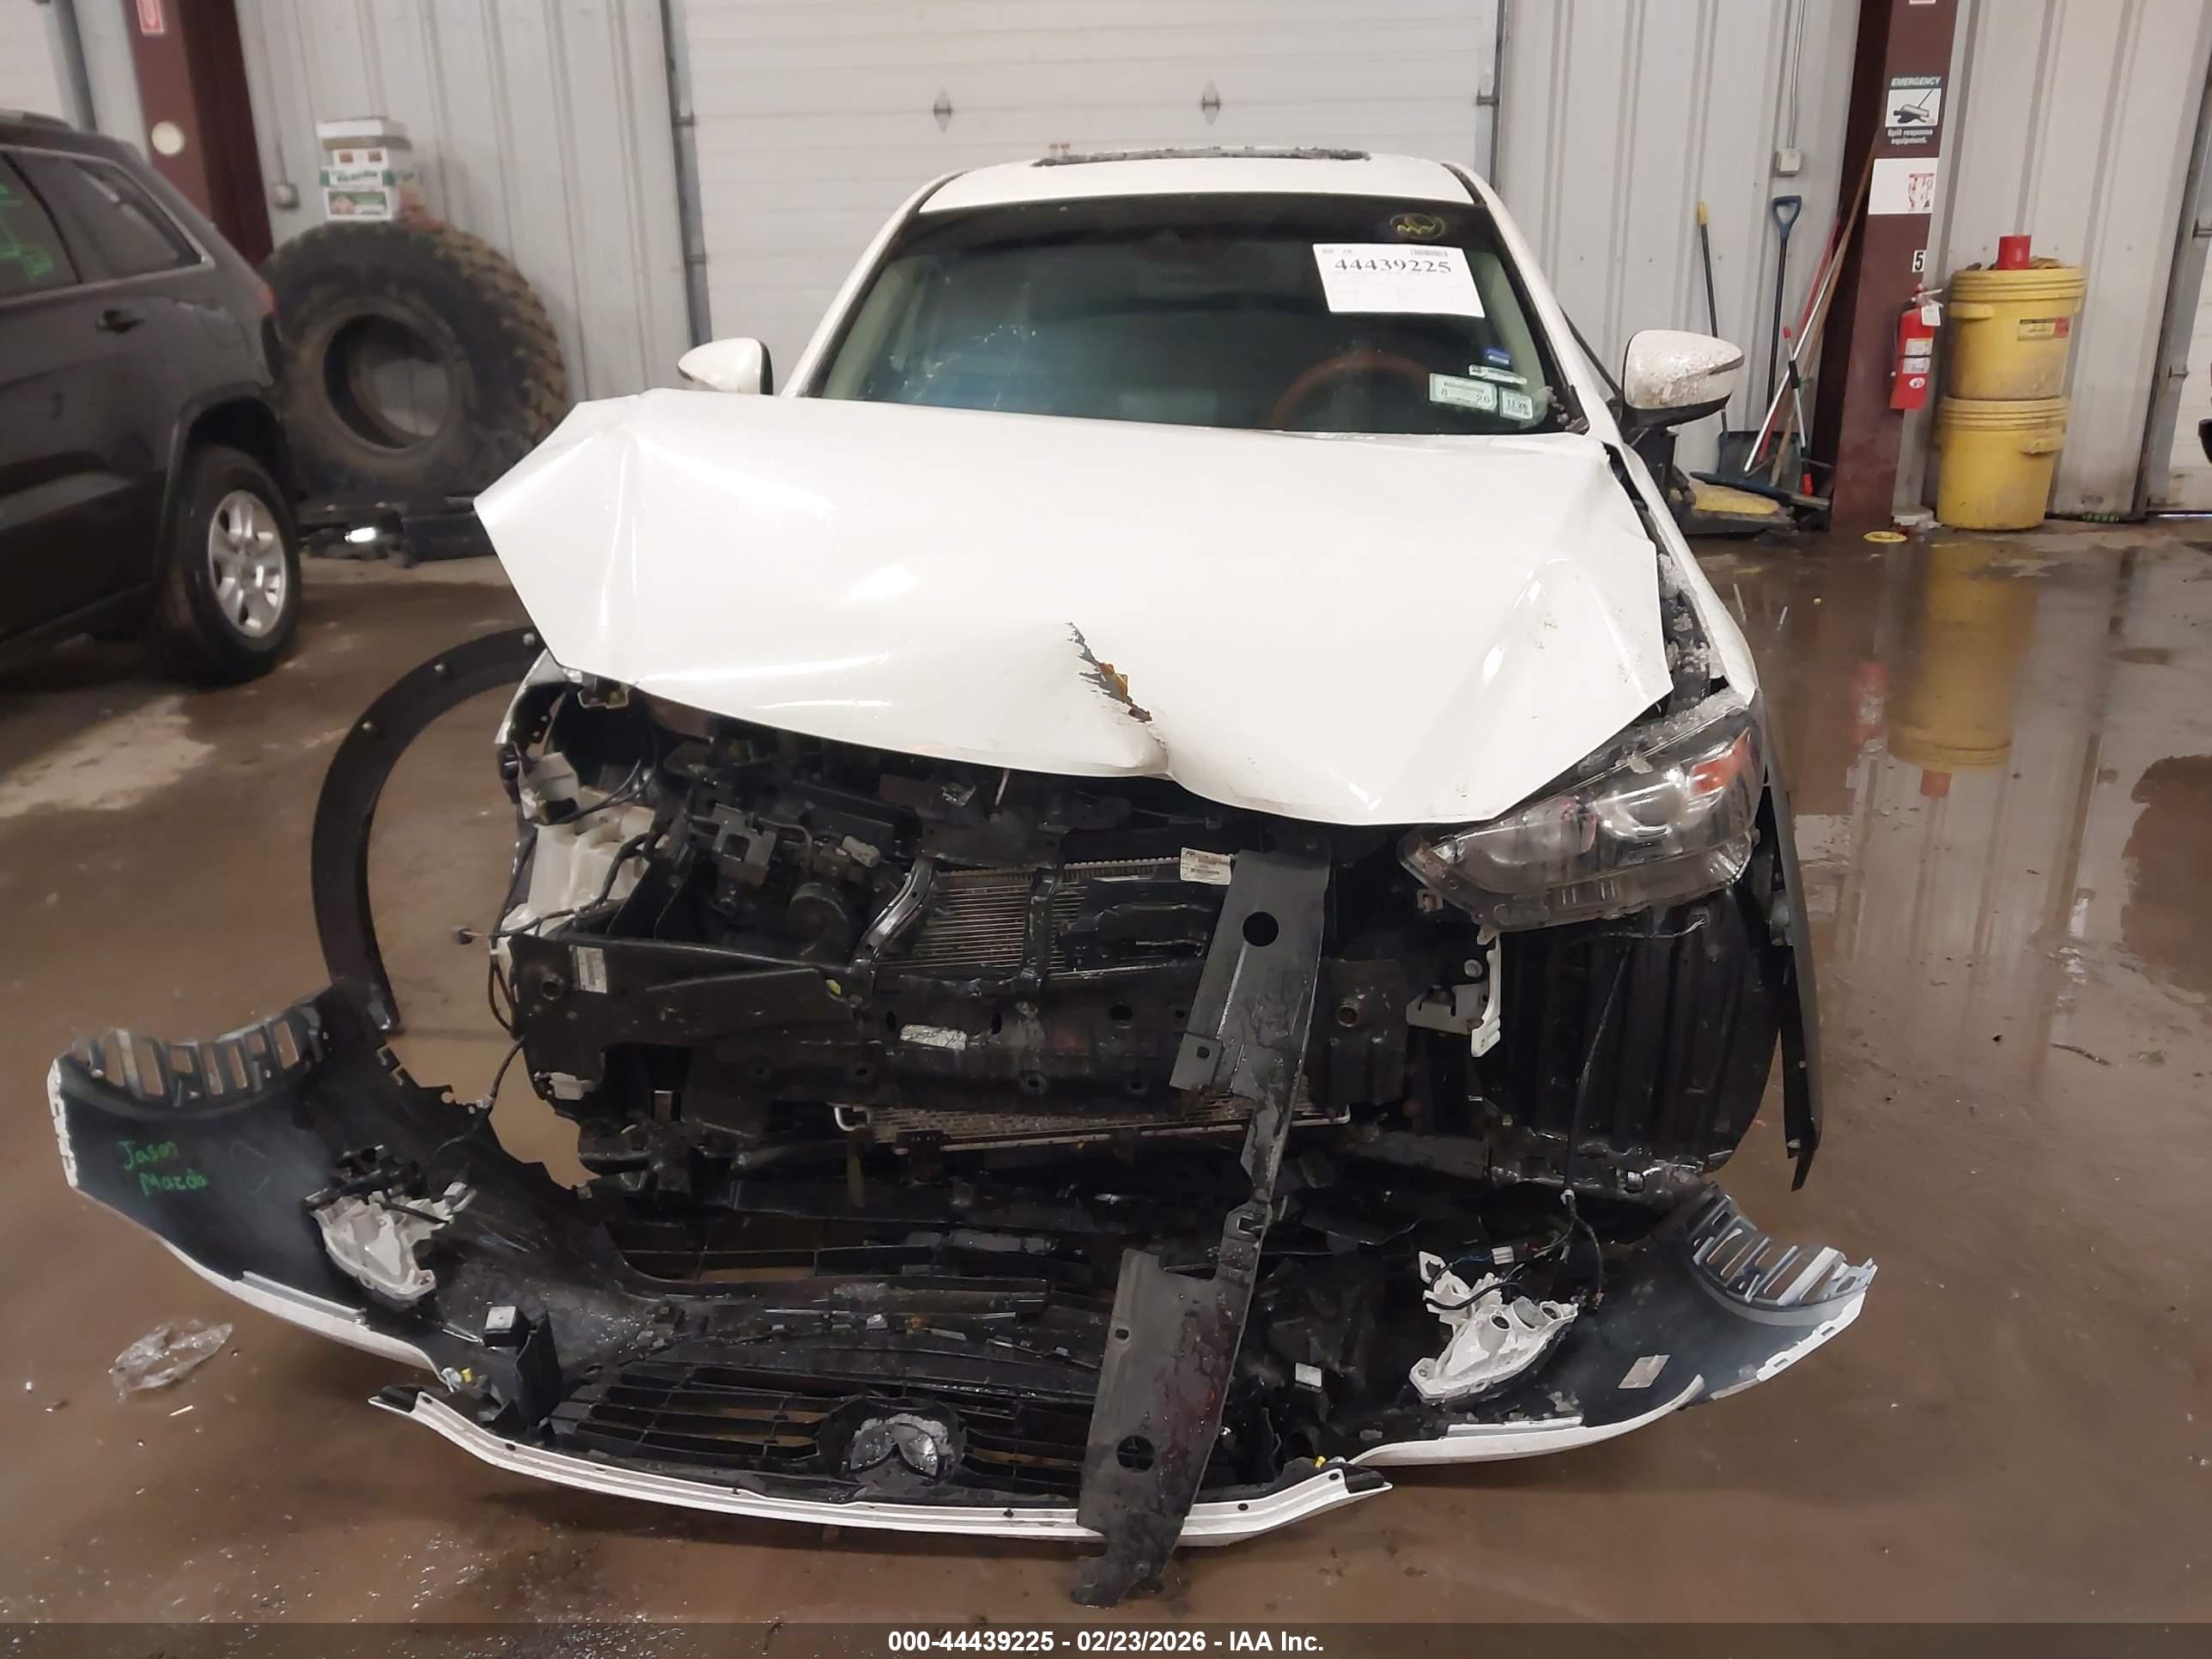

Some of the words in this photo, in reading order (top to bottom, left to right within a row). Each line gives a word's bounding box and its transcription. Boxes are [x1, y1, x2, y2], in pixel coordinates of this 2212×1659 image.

[1891, 76, 1942, 87] EMERGENCY
[1334, 258, 1452, 274] 44439225
[1914, 251, 1924, 271] 5
[117, 1140, 179, 1170] Jason
[137, 1168, 209, 1197] Mazda
